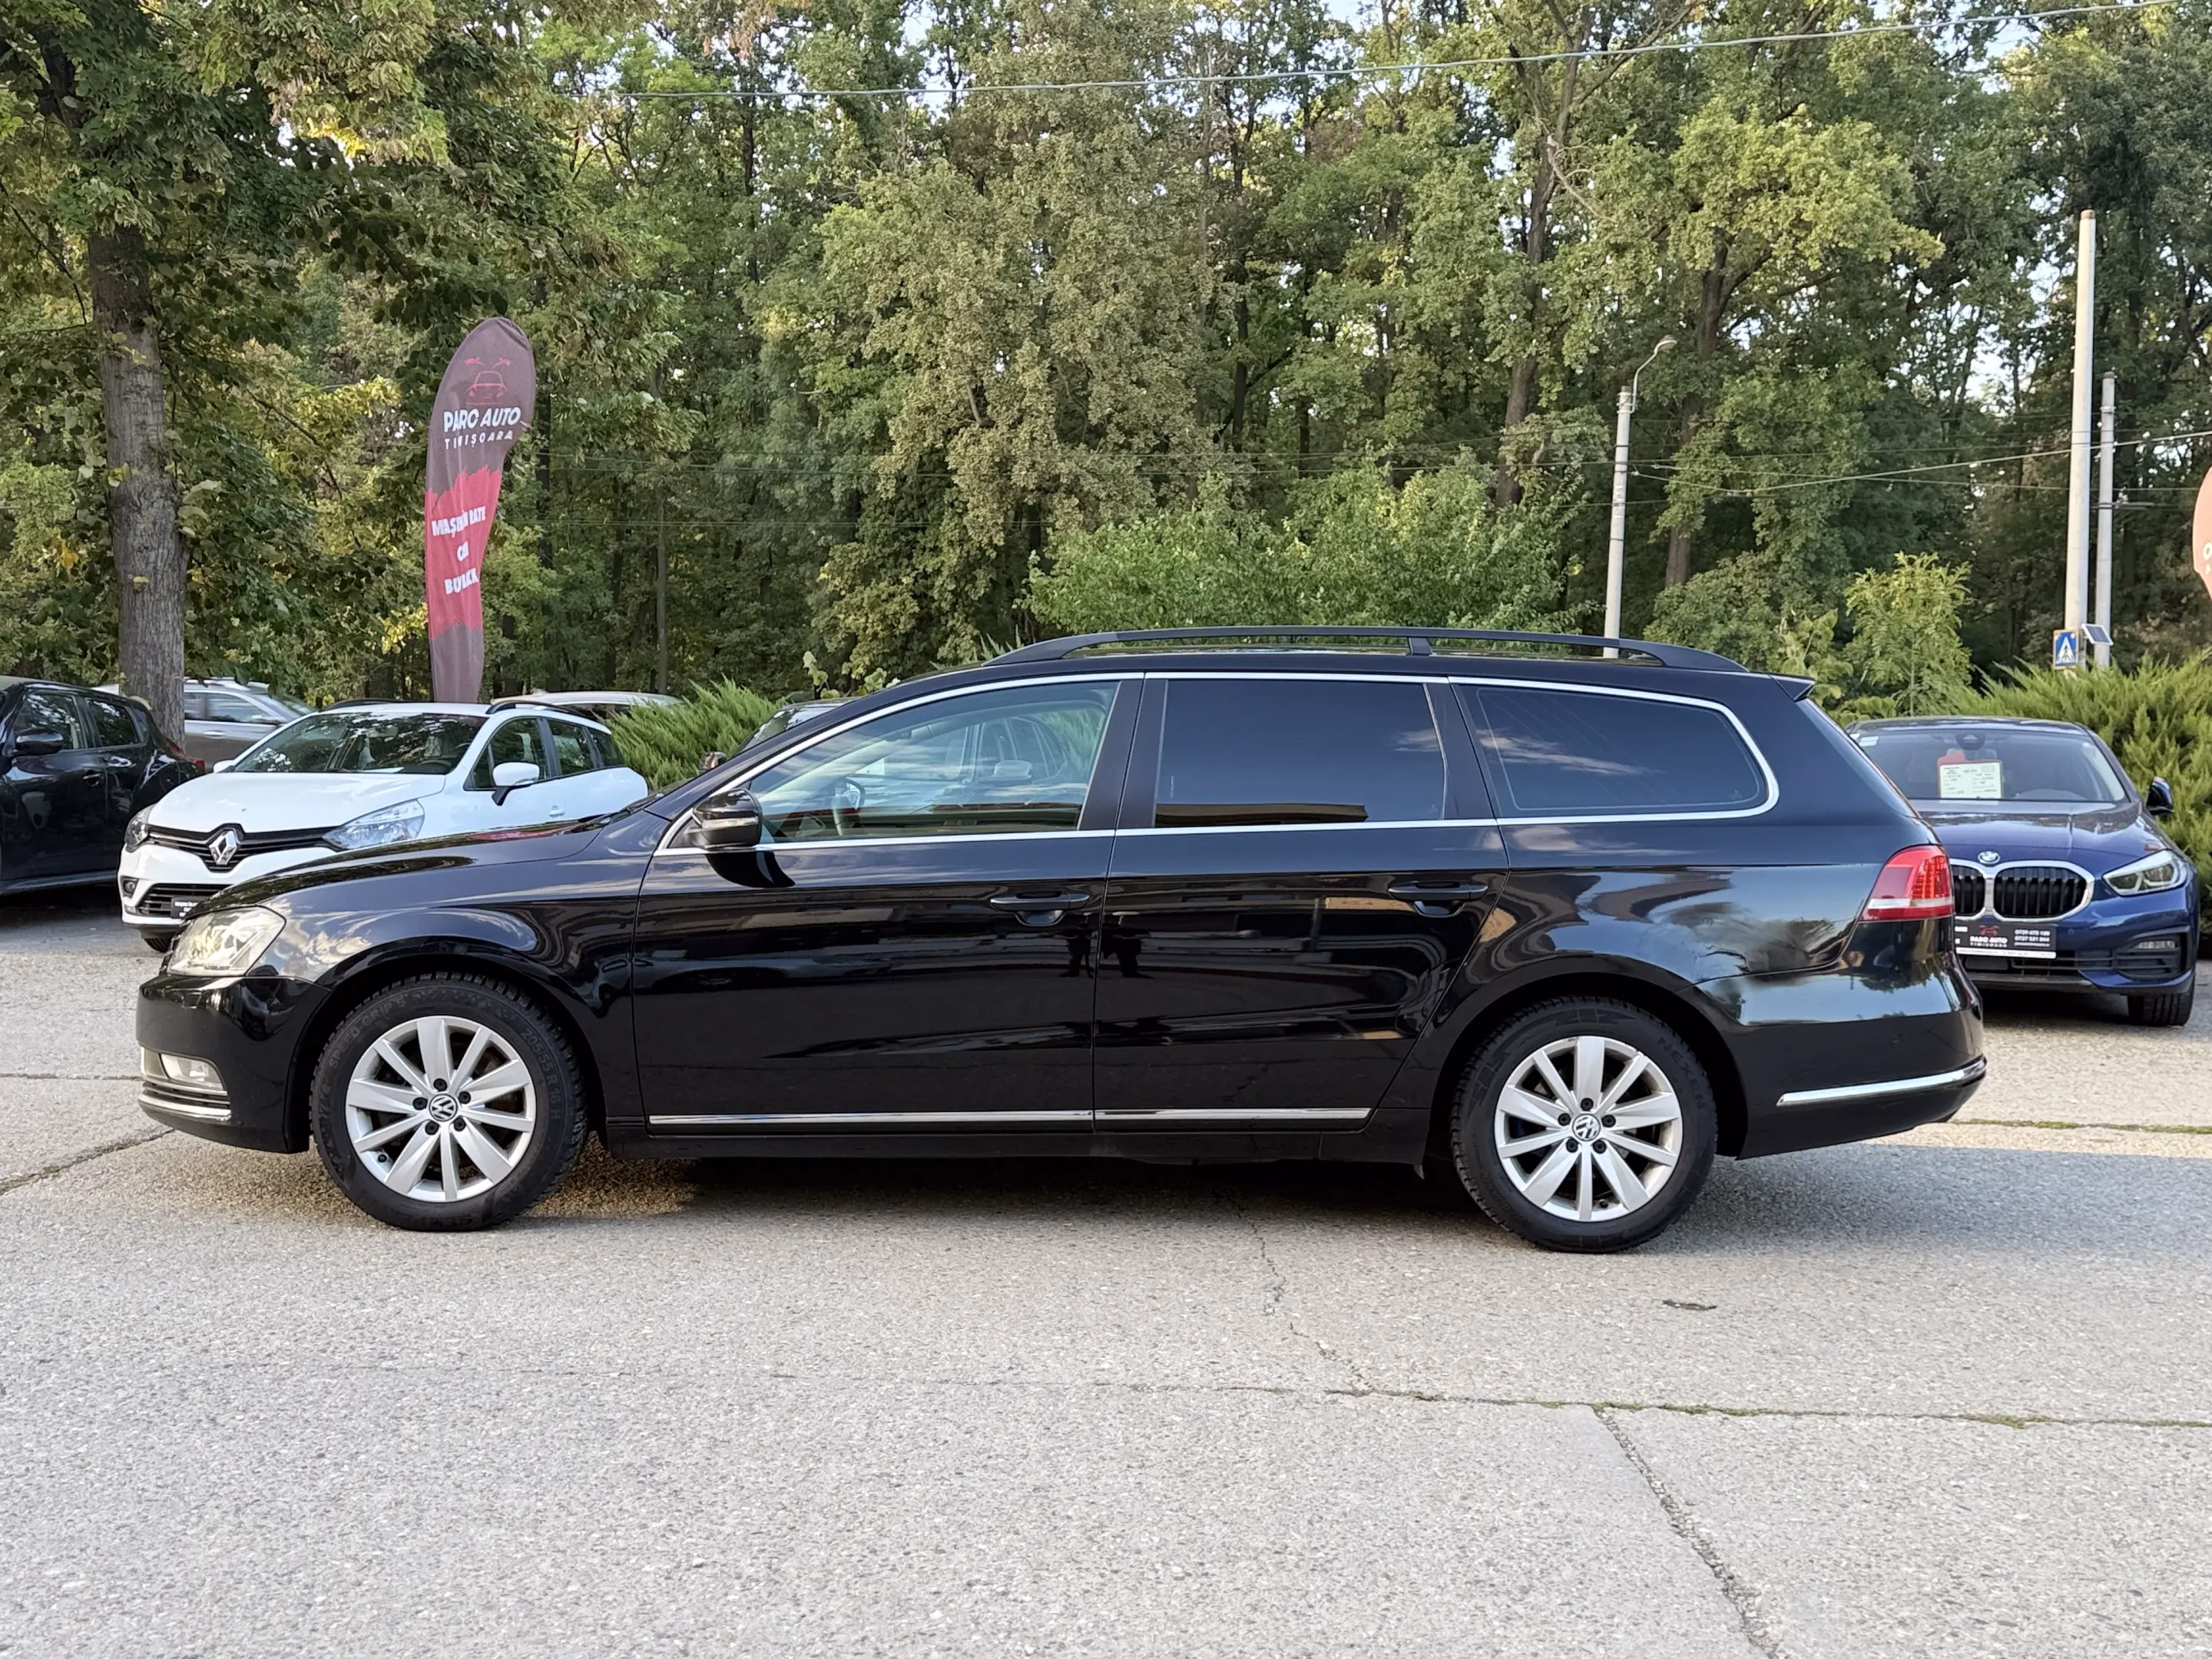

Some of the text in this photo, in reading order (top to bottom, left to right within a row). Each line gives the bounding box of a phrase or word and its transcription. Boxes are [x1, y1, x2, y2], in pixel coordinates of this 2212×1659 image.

[444, 406, 522, 432] PARC AUTO
[519, 1028, 554, 1073] 205/55
[1657, 1036, 1707, 1110] NEXEN
